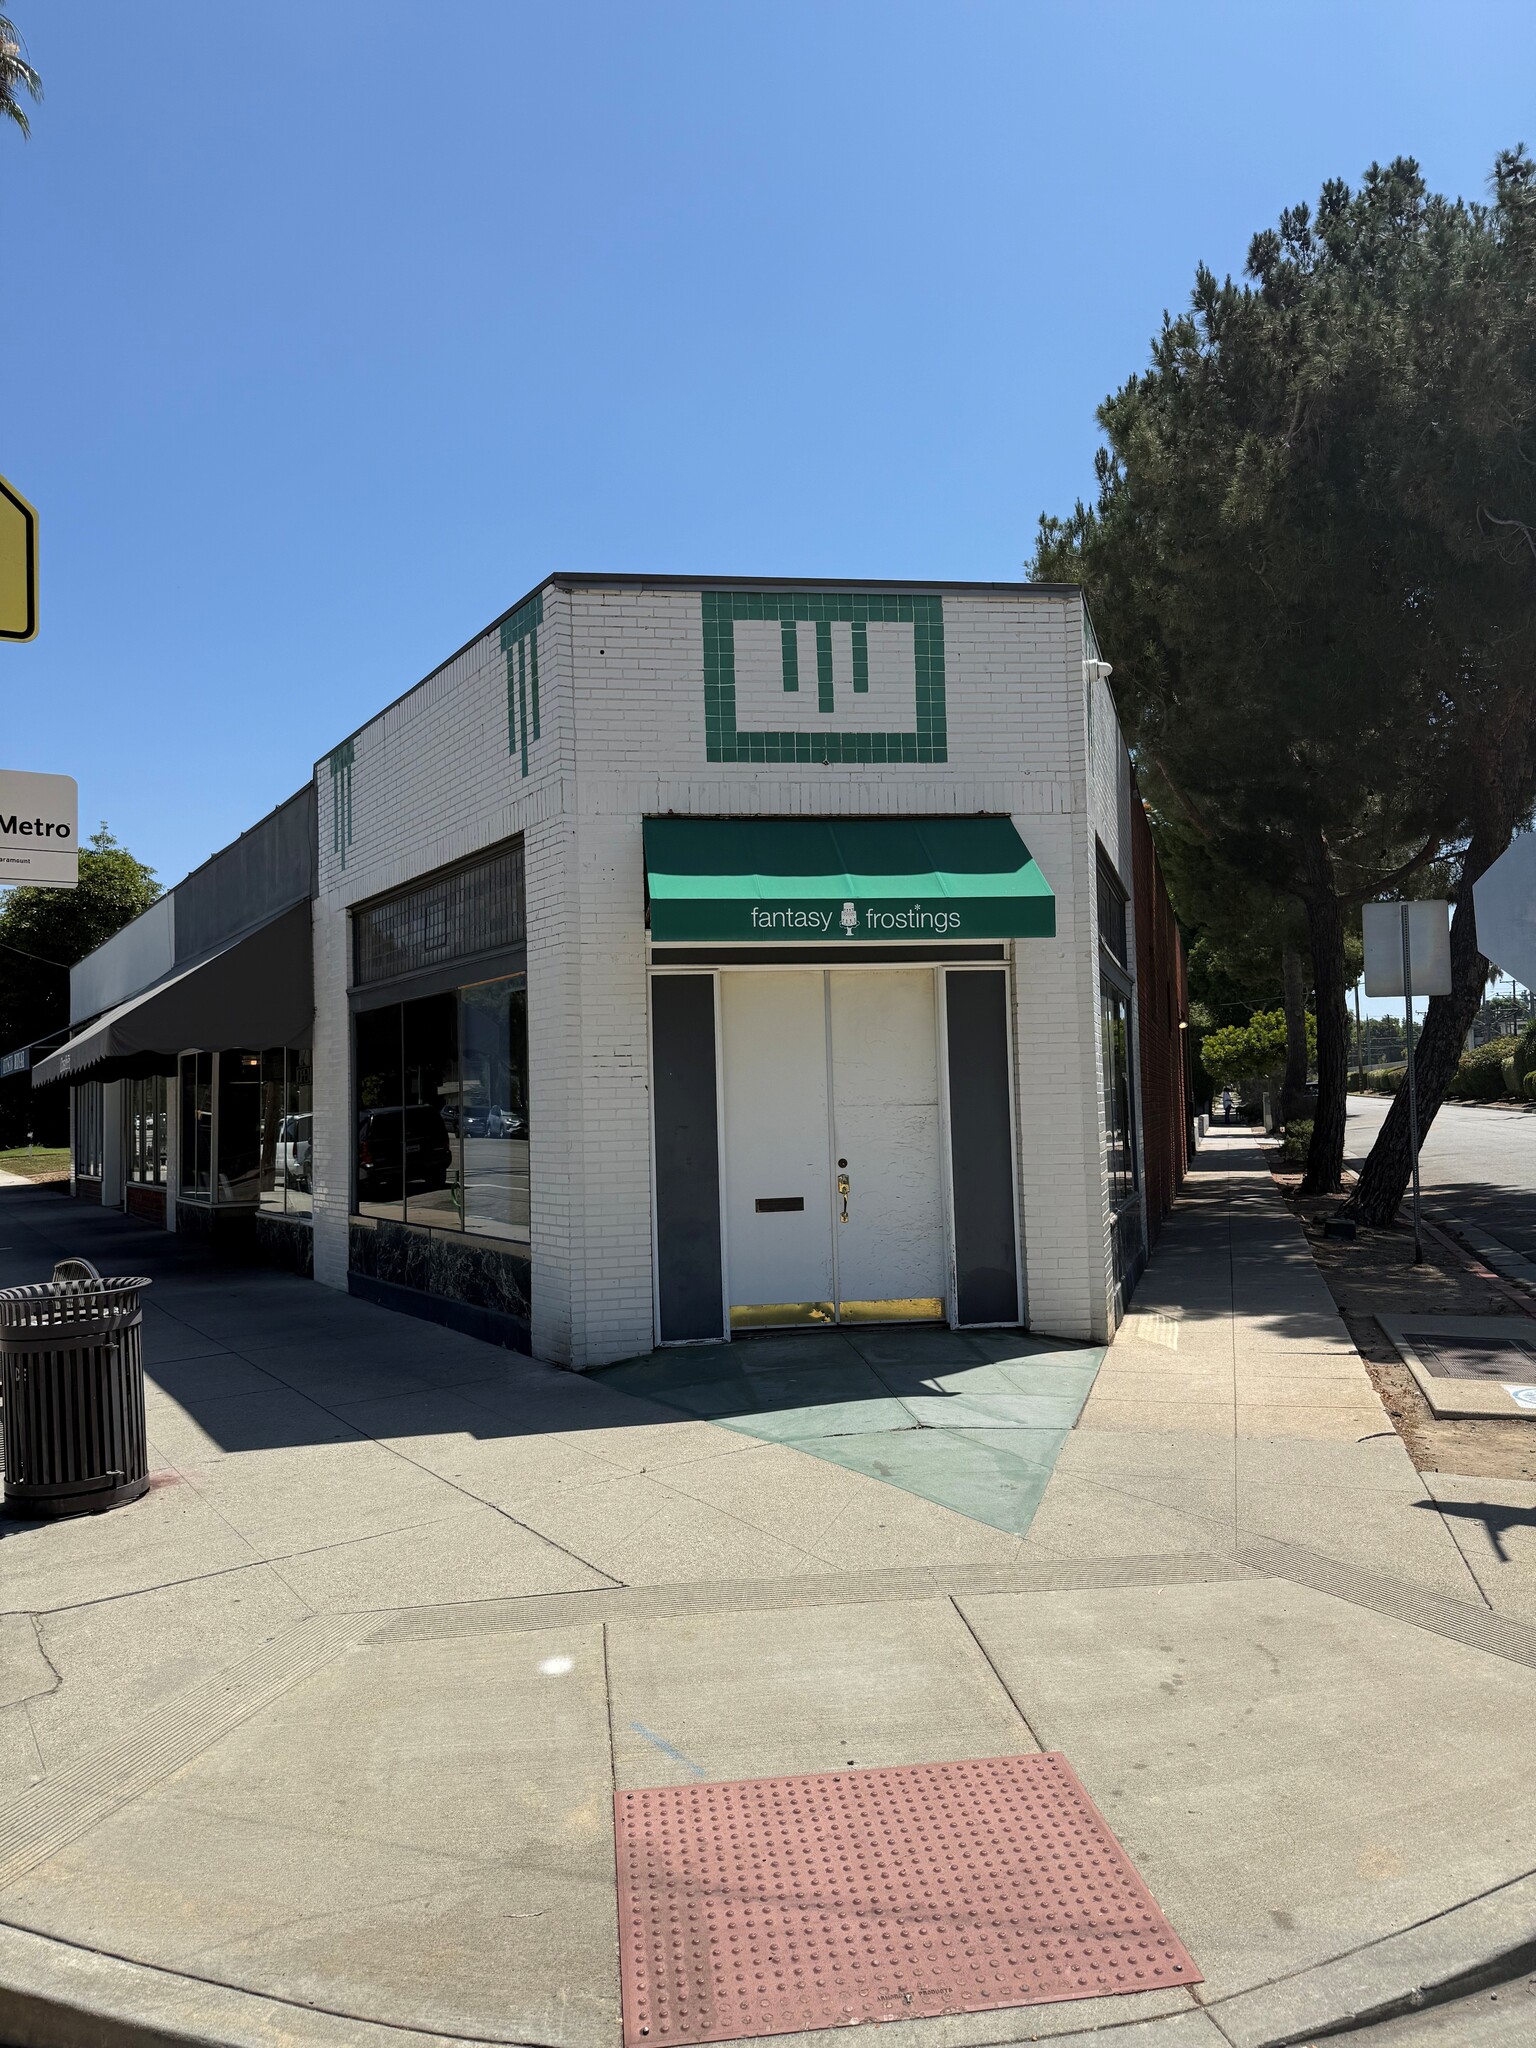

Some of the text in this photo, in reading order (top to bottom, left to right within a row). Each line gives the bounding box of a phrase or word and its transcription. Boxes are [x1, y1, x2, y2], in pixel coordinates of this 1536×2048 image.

[0, 815, 71, 838] Metro
[750, 904, 961, 933] fantasy frostings
